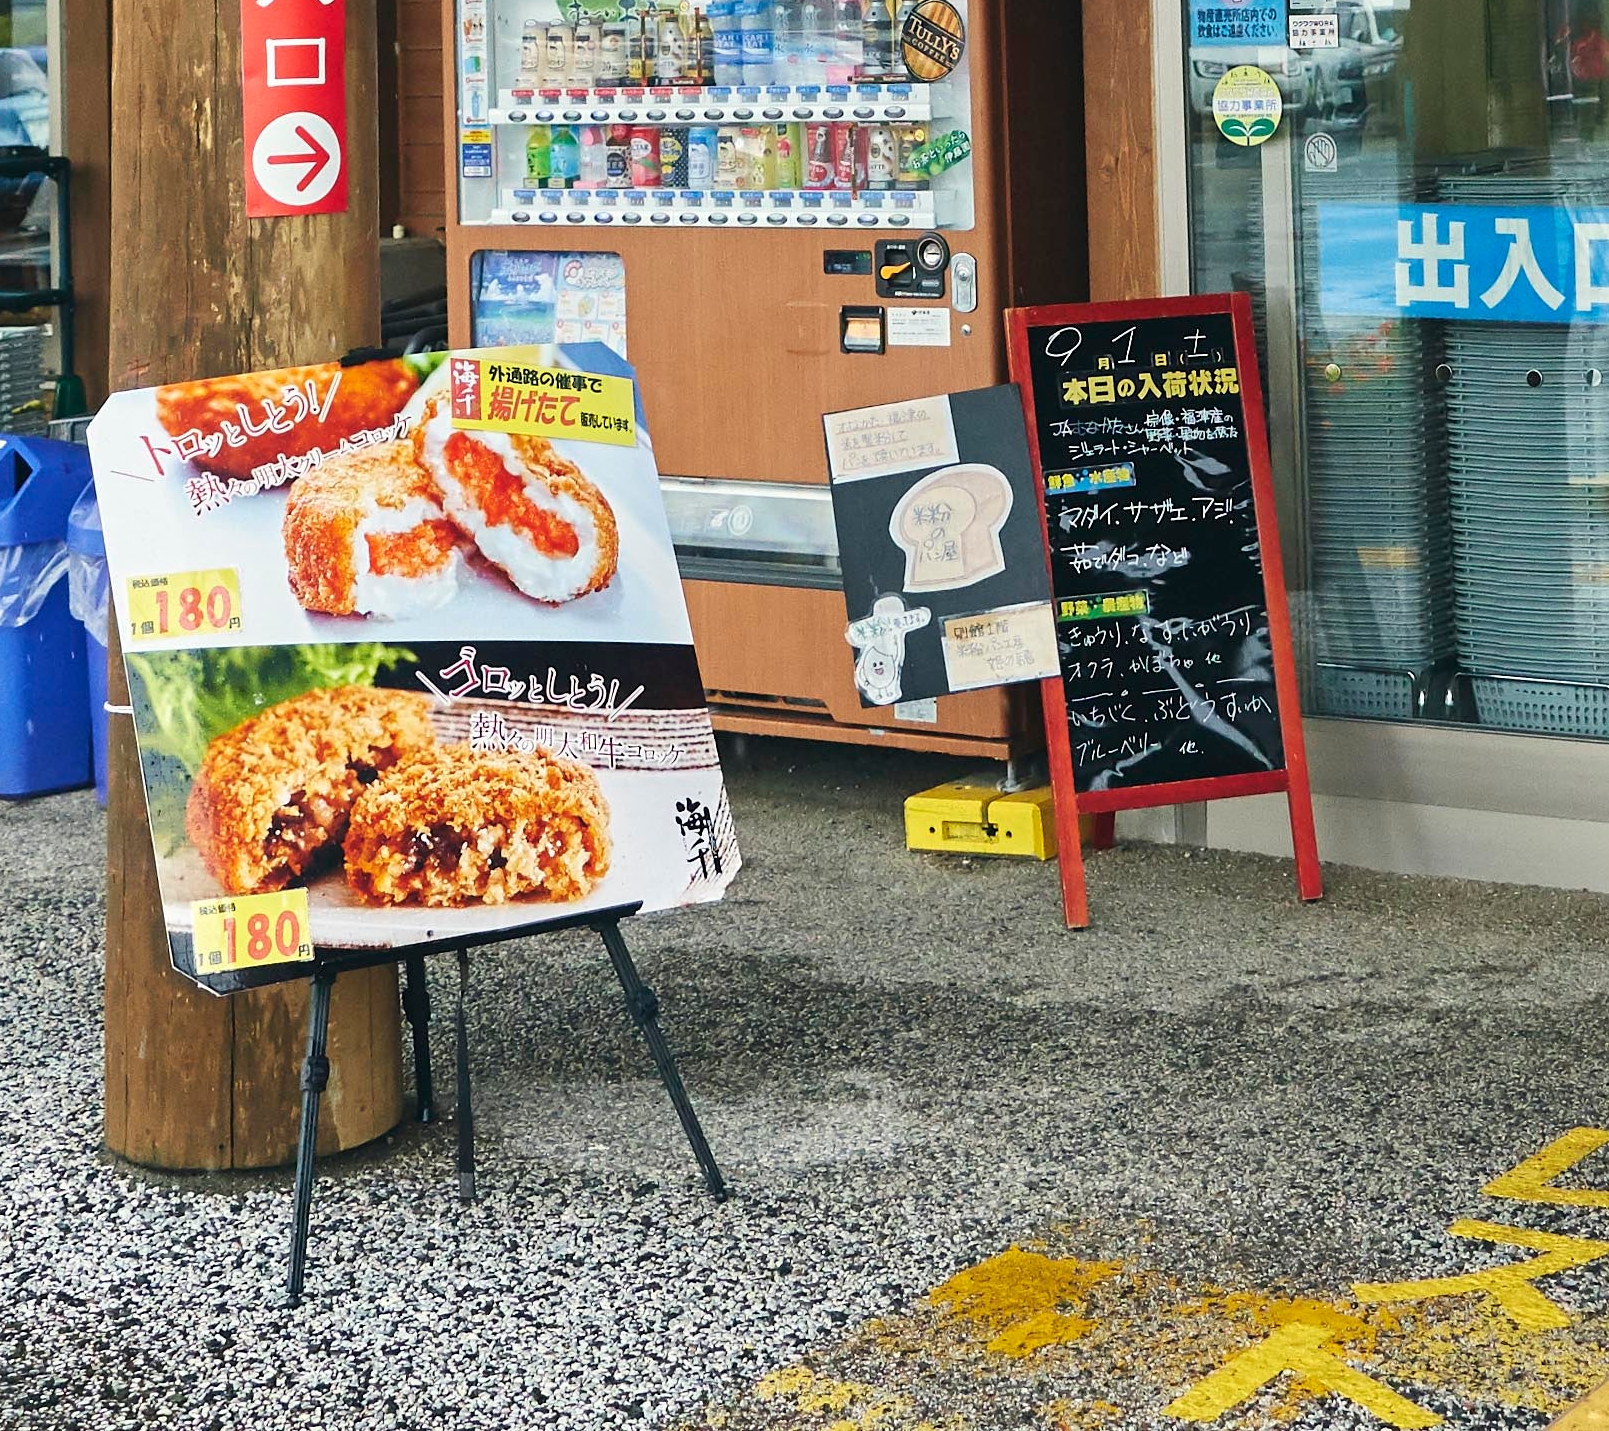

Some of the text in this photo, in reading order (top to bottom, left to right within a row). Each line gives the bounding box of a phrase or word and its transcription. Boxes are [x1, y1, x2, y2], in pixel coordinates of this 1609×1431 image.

[908, 15, 961, 61] TULLY'S
[911, 38, 946, 64] COFFEE
[1217, 98, 1278, 113] 協力事業所
[910, 129, 967, 170] お茶といったら
[944, 139, 970, 164] 伊藤園
[488, 365, 603, 394] 外通路の催事で
[1062, 367, 1240, 406] 本日の入荷状況
[486, 385, 581, 427] 揚げたて
[186, 413, 413, 517] 熱々の明太クリームコロッケ
[913, 502, 953, 527] 米粉
[930, 527, 945, 540] の
[918, 541, 959, 565] パン屋
[132, 577, 169, 590] 税込価格
[470, 711, 687, 769] 熱々の明太和牛コロッケ
[1076, 732, 1162, 767] ブルーベリー
[199, 902, 236, 916] 税込価格
